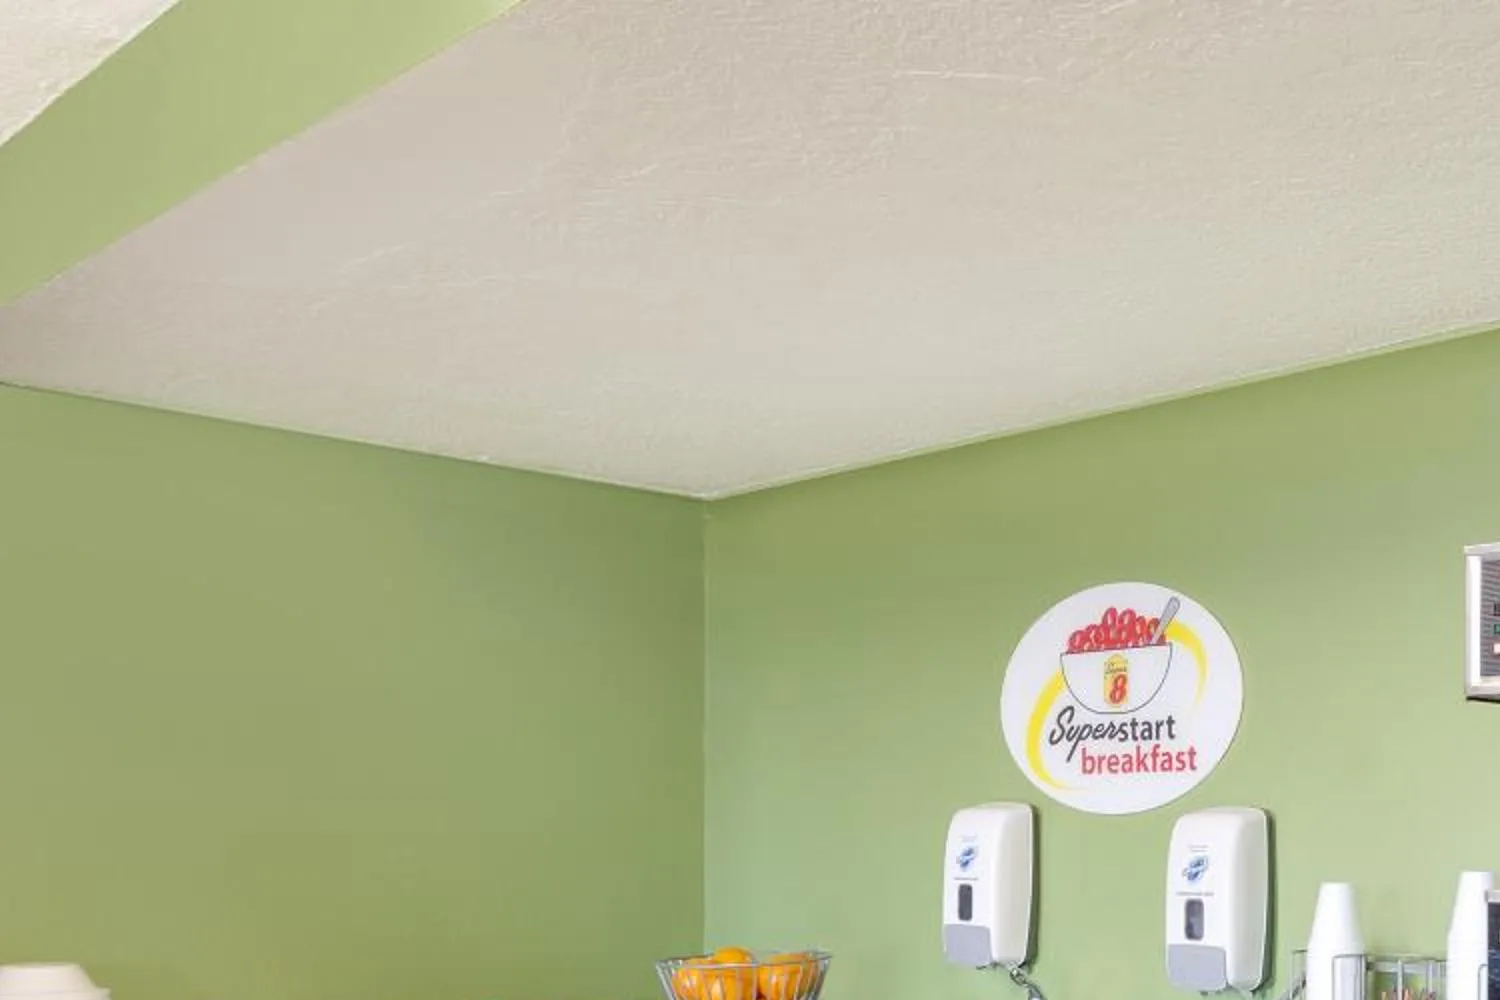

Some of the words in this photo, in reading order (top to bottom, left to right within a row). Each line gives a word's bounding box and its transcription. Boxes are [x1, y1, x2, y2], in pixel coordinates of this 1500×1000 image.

[1109, 673, 1127, 704] 8
[1049, 705, 1176, 762] Superstart
[1081, 744, 1198, 775] breakfast
